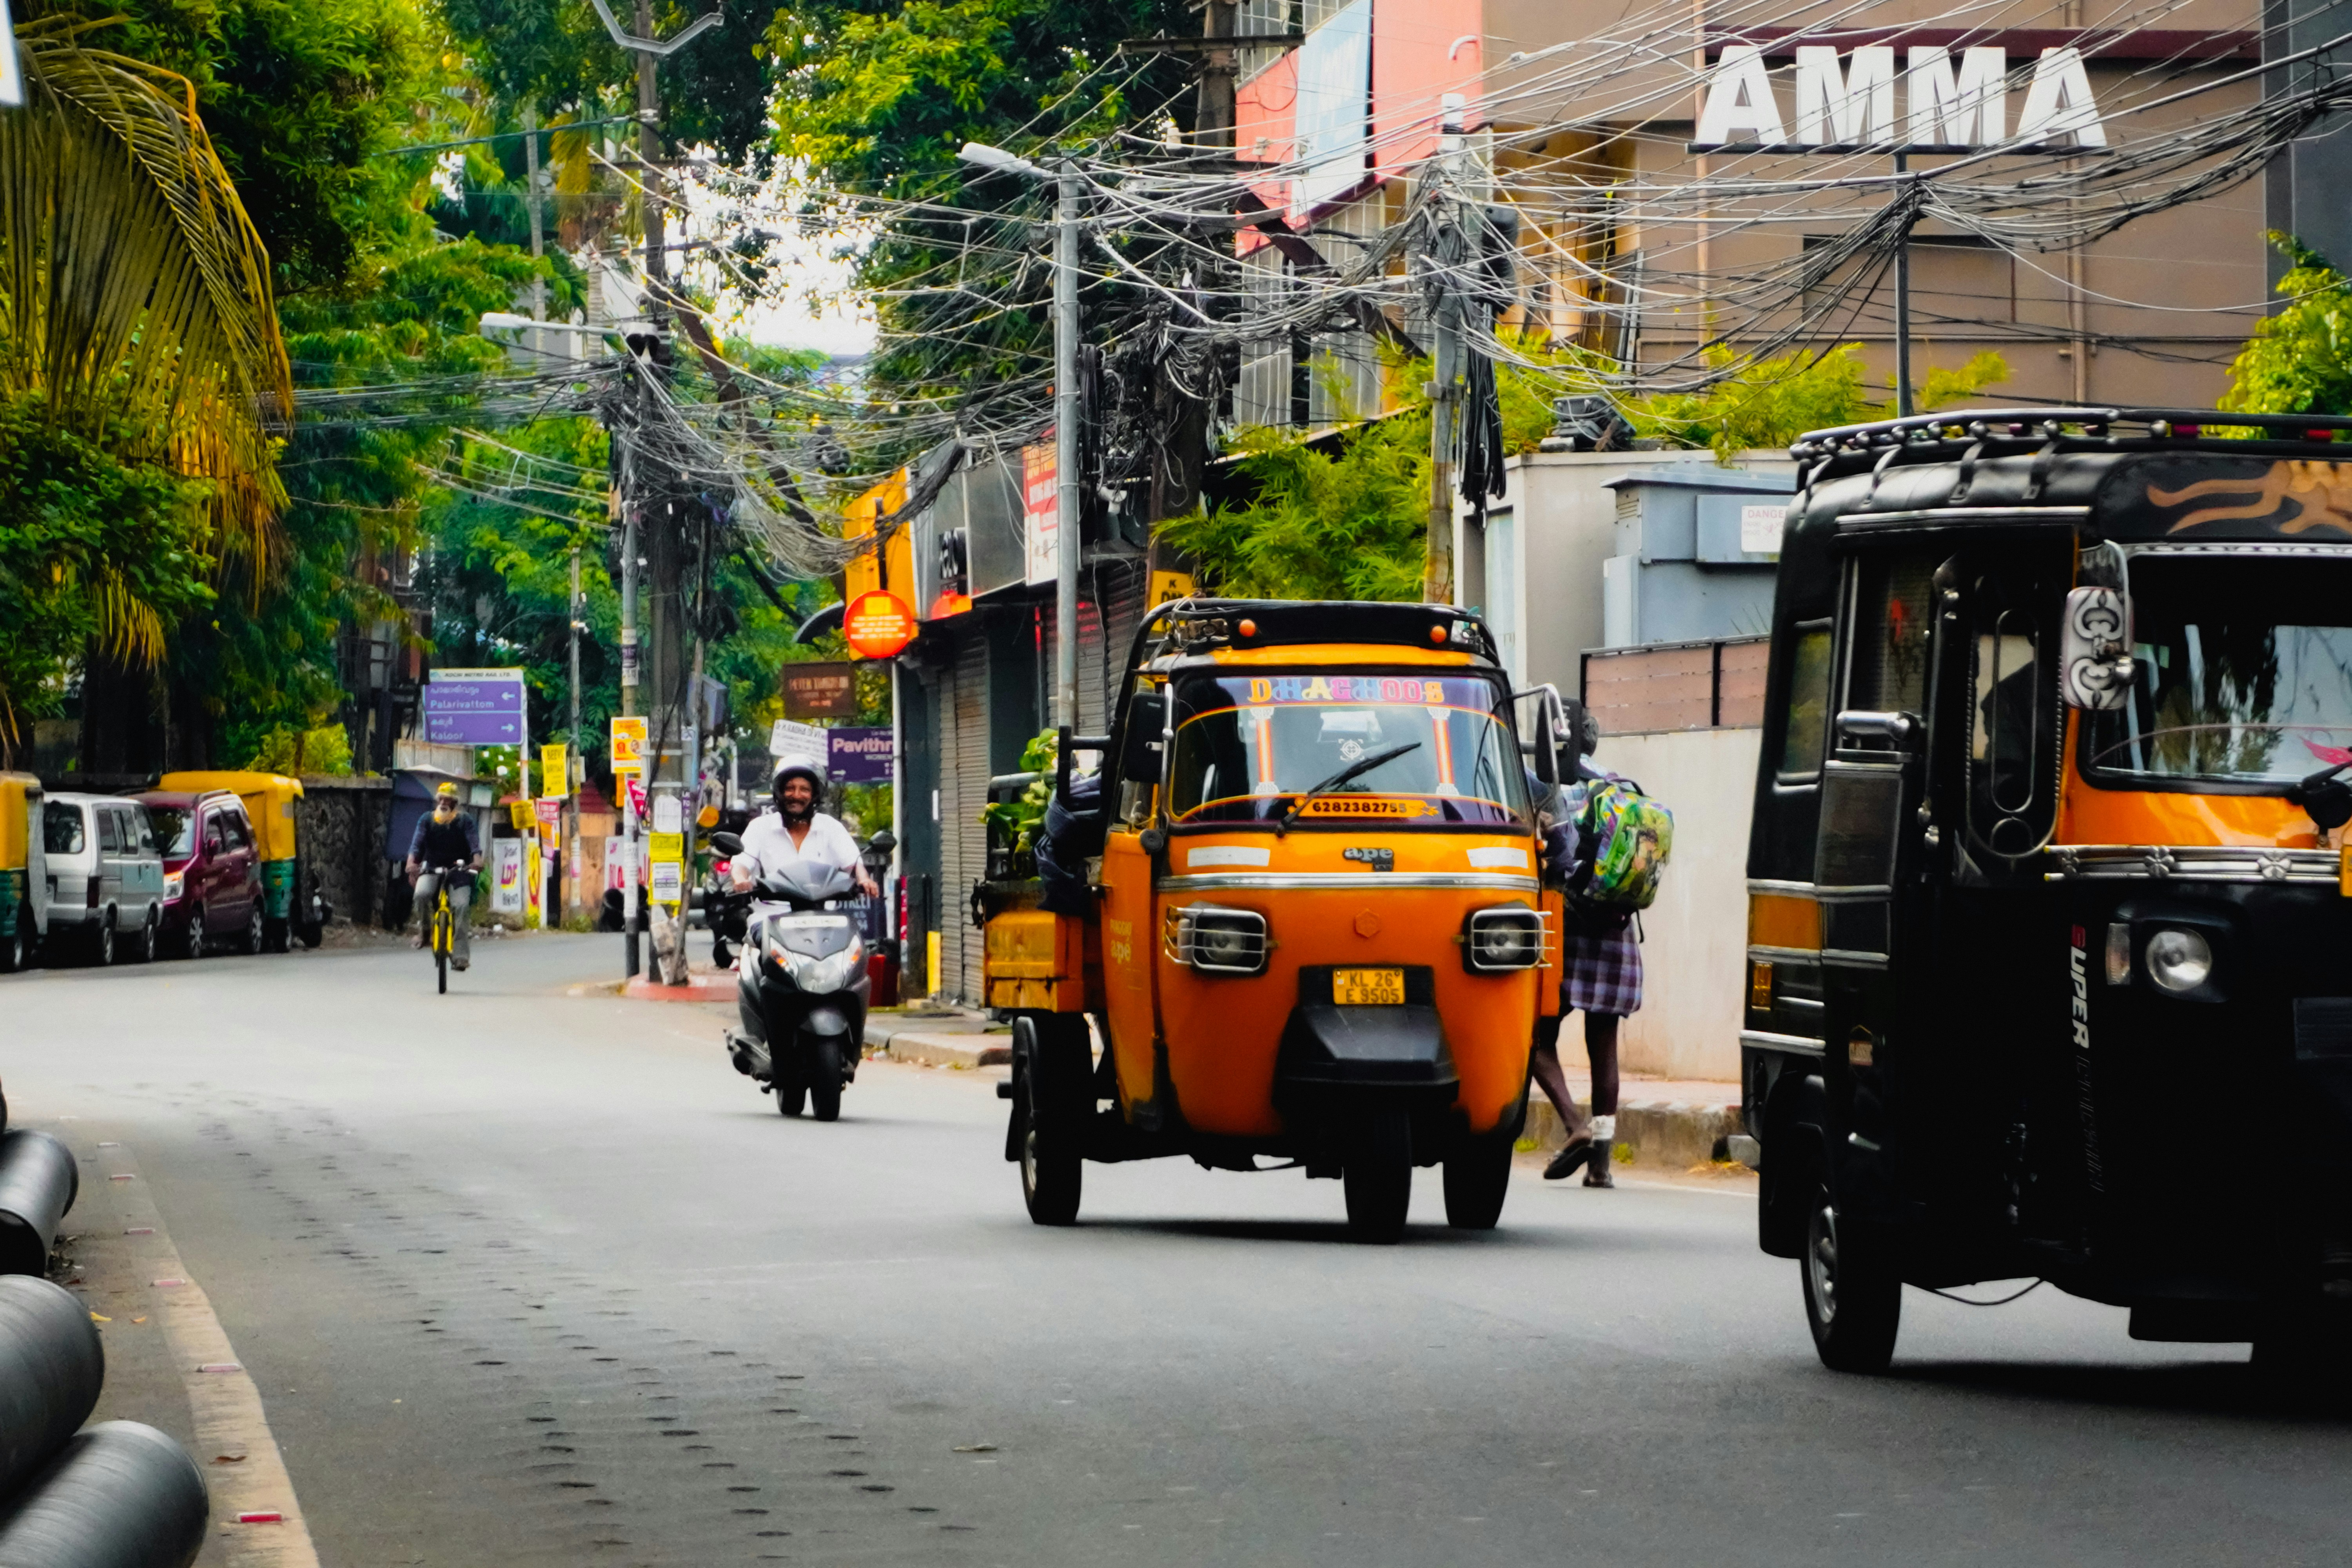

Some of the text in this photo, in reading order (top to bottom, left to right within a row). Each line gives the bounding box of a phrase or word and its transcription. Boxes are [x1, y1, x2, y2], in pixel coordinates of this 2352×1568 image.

[1695, 46, 2107, 146] AMMA
[430, 700, 494, 708] Palarivattom
[431, 731, 464, 740] Kaloor
[1345, 848, 1393, 861] ape
[1350, 972, 1393, 987] KL 26
[1346, 988, 1400, 1002] E 9505
